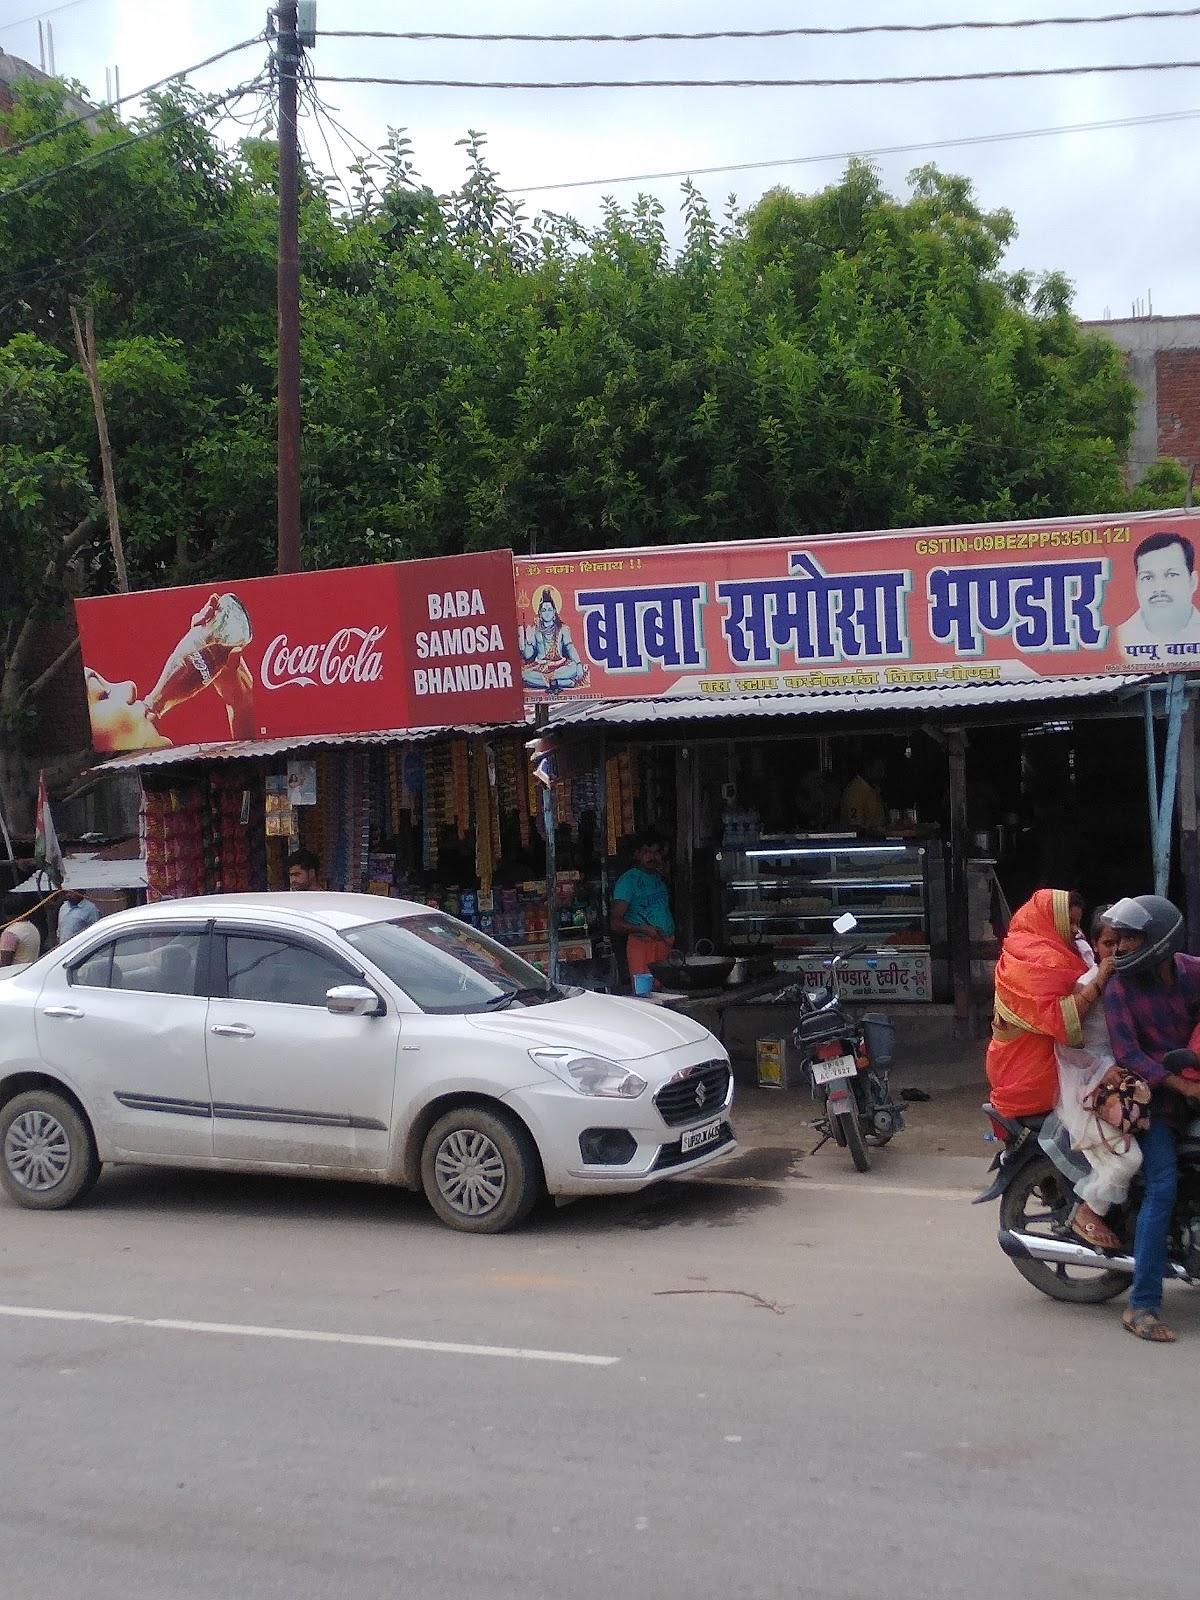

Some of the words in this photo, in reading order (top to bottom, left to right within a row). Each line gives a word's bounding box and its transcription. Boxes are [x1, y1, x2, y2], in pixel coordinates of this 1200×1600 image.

[427, 588, 486, 620] BABA
[575, 583, 704, 672] बाबा
[716, 552, 908, 664] समोसा
[927, 559, 1105, 653] भण्डार
[260, 624, 389, 690] Coca-Cola
[415, 624, 505, 659] SAMOSA
[1123, 643, 1161, 660] पप्पू
[413, 661, 514, 695] BHANDAR
